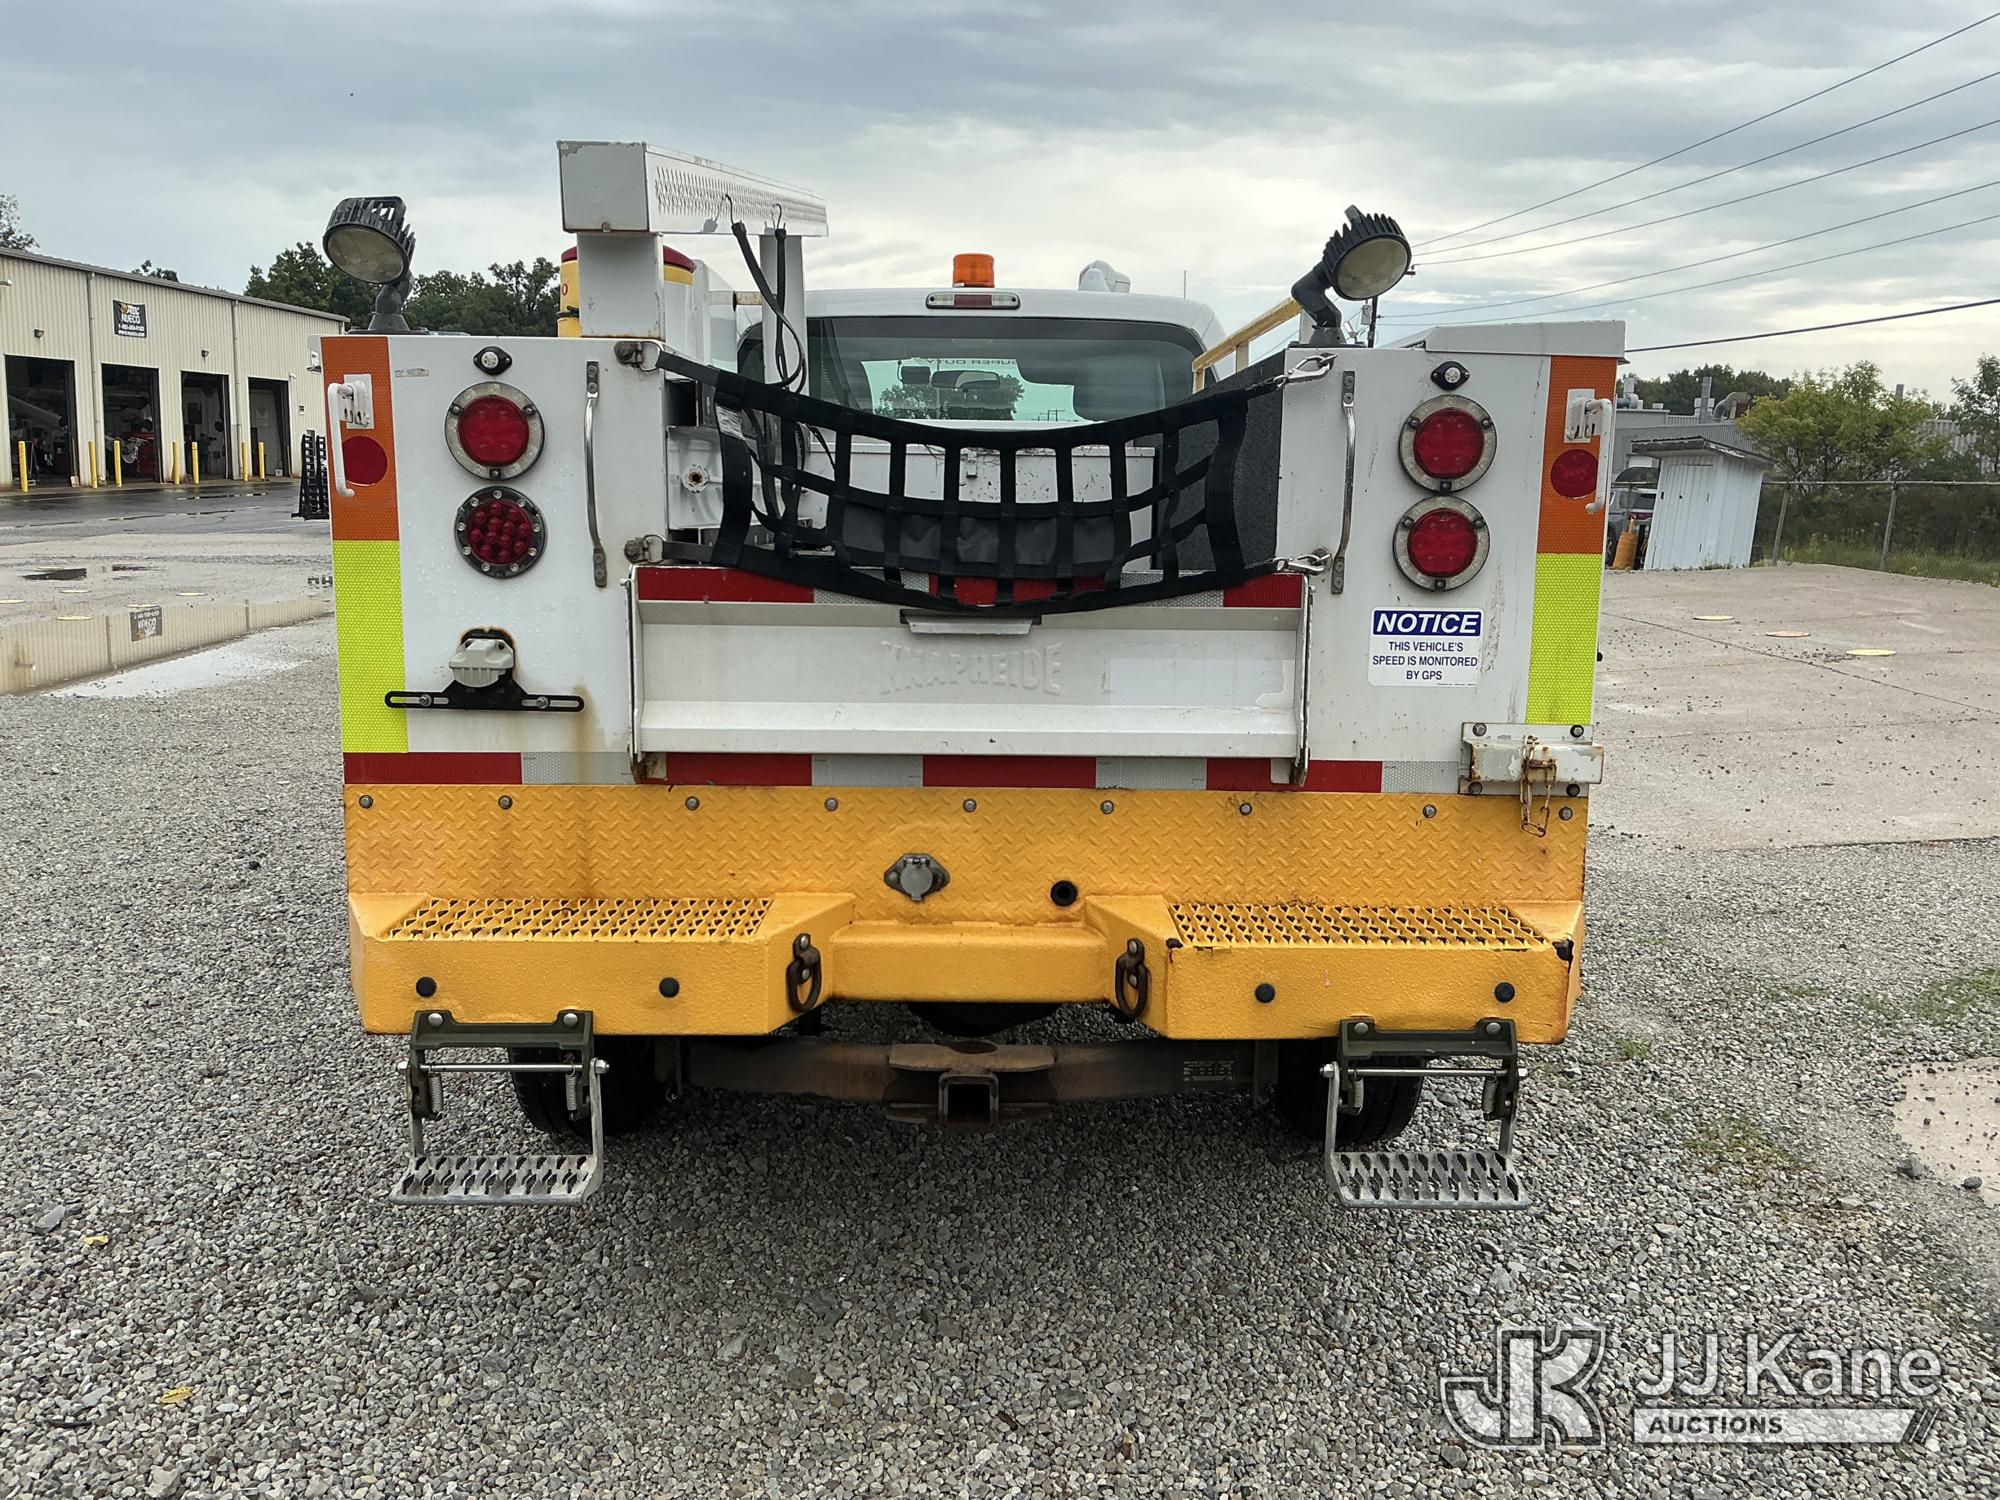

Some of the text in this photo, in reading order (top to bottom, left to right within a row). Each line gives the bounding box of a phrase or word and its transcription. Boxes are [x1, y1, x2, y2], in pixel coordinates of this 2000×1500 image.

[1376, 613, 1479, 633] NOTICE
[1389, 641, 1464, 652] THIS VEHICLE'S
[1372, 655, 1478, 667] SPEED IS MONITORED
[880, 640, 1062, 697] KNAPHEIDE
[1405, 670, 1443, 680] BY GPS
